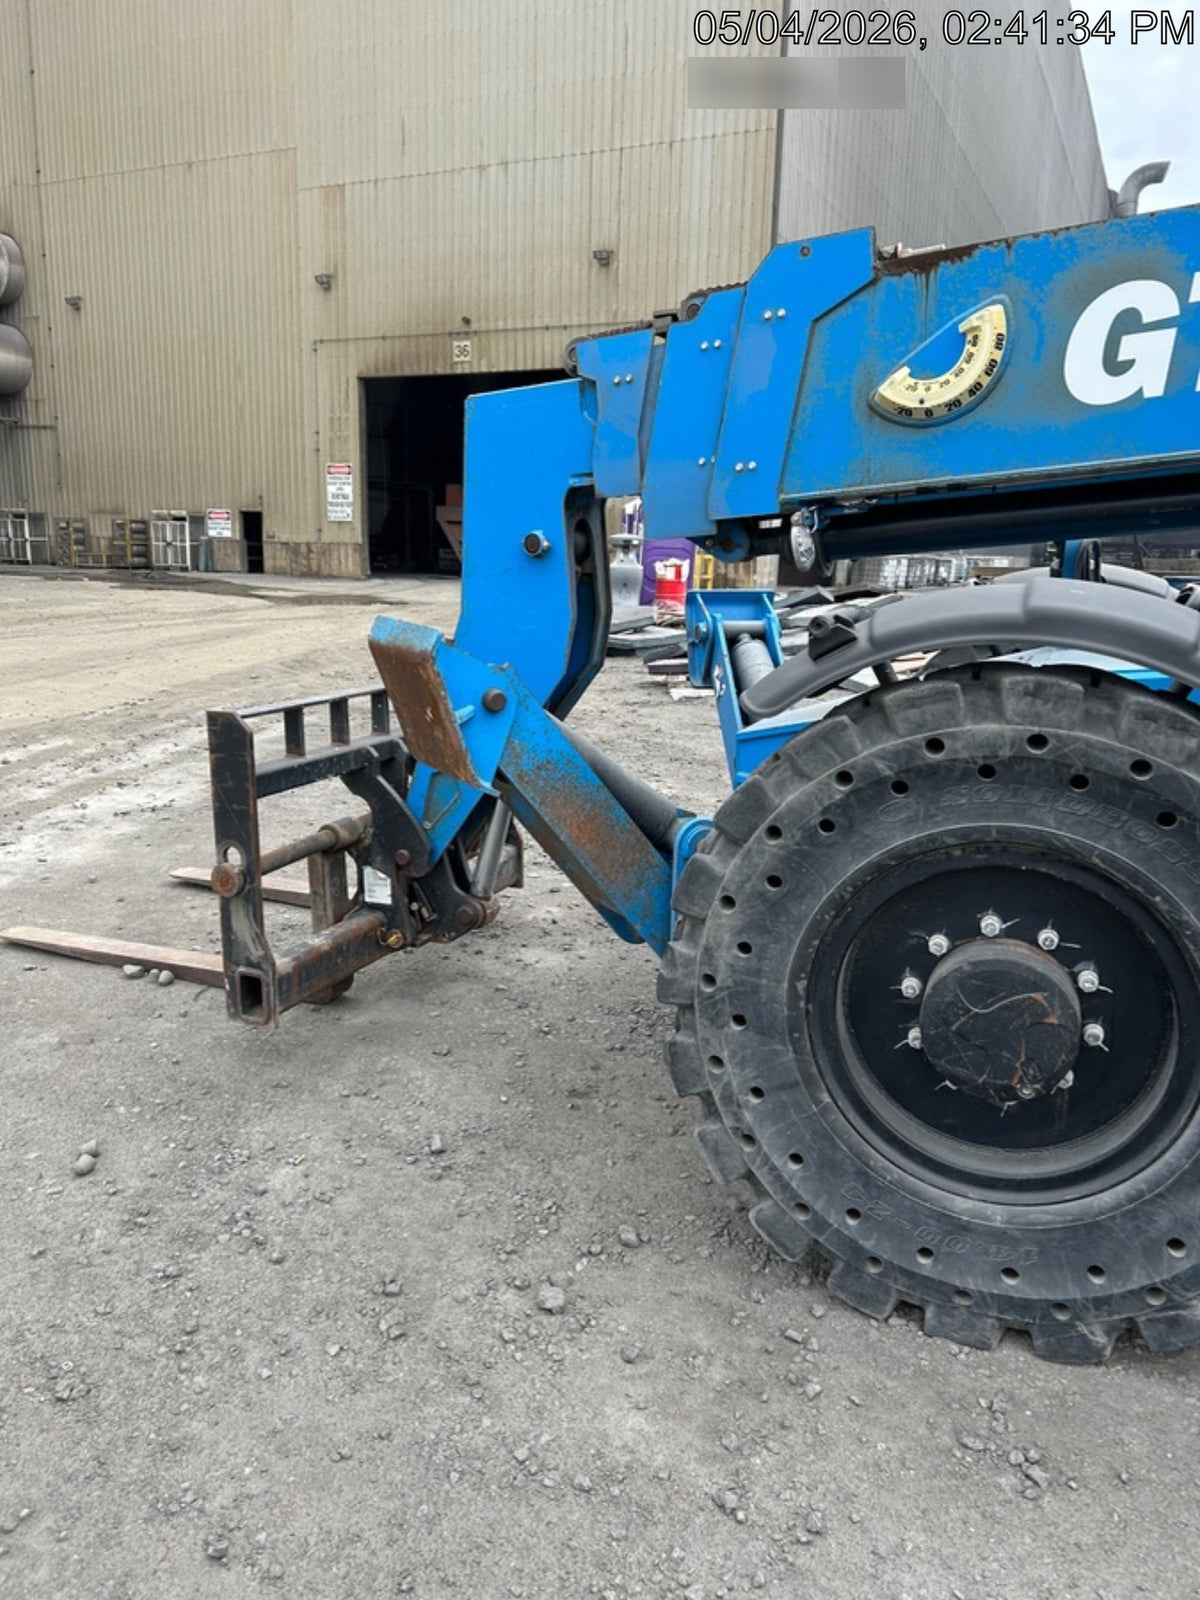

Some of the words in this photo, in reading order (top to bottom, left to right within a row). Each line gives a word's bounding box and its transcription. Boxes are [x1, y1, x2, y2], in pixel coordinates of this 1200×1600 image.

[455, 344, 470, 358] 36
[924, 408, 933, 418] 0
[944, 398, 963, 413] 20
[968, 382, 983, 398] 40
[984, 359, 998, 377] 60
[995, 333, 1005, 351] 80
[1063, 271, 1200, 405] G
